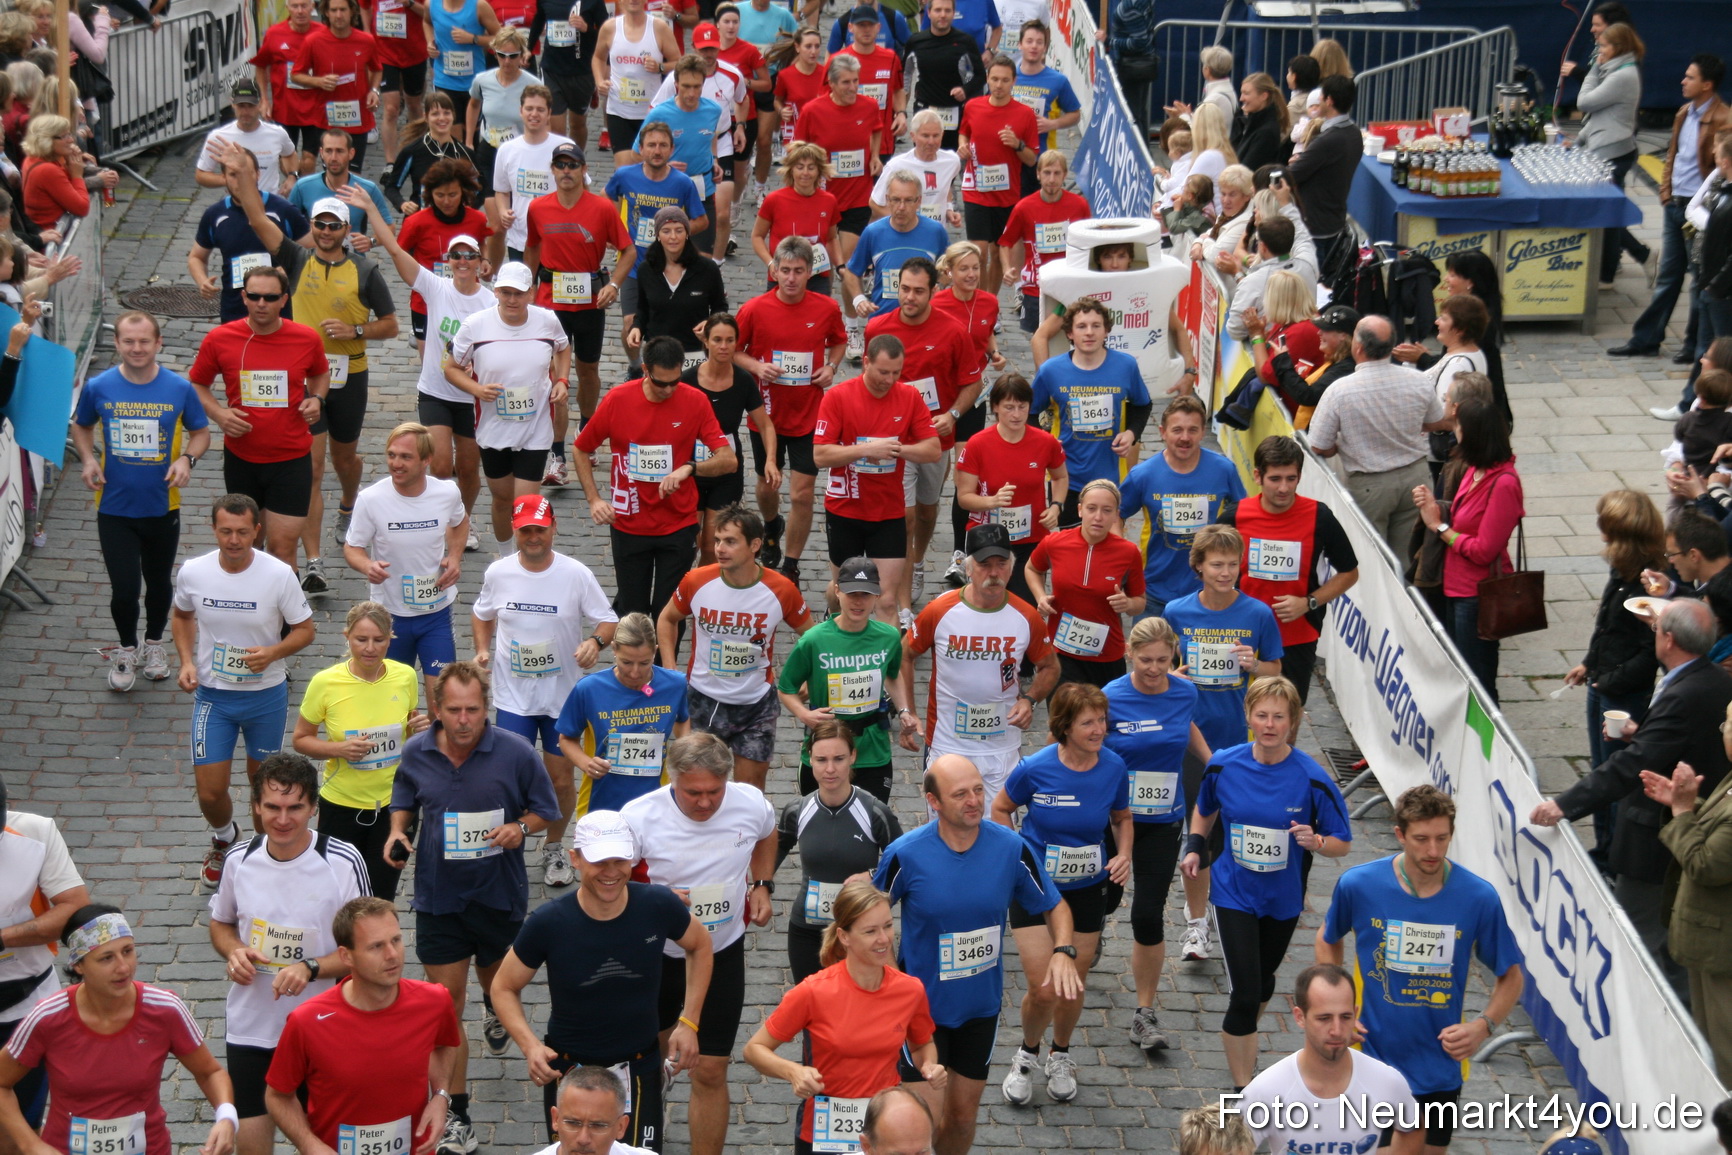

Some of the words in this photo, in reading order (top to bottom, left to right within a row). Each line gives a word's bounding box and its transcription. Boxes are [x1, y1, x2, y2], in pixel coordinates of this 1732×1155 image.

[385, 22, 404, 30] 2529
[554, 30, 573, 38] 3120
[451, 60, 470, 68] 3664
[630, 89, 646, 97] 934
[337, 111, 357, 119] 2570
[841, 160, 861, 169] 3289
[985, 174, 1005, 183] 3550
[526, 181, 550, 191] 2143
[637, 193, 679, 204] NEUMARKTER
[1046, 233, 1067, 243] 2911
[1506, 232, 1587, 273] Glossner
[1547, 255, 1583, 272] Bier
[562, 275, 577, 283] Frank
[566, 284, 585, 294] 658
[784, 354, 796, 362] Fritz
[784, 365, 809, 375] 3545
[252, 373, 283, 382] Alexander
[258, 385, 280, 396] 581
[1070, 386, 1121, 394] NEUMARKTER
[104, 402, 114, 410] 10.
[115, 402, 174, 412] NEUMARKTER
[509, 398, 534, 410] 3313
[763, 389, 771, 415] MAX
[1081, 399, 1100, 407] Martin
[113, 409, 163, 418] STADTLAUF
[1083, 408, 1109, 419] 3643
[122, 422, 145, 430] Markus
[124, 433, 152, 444] 3011
[639, 448, 668, 457] Maximilian
[640, 459, 668, 470] 3563
[850, 472, 860, 499] MAX
[629, 486, 640, 514] MAX
[1174, 501, 1193, 511] Georg
[1175, 510, 1204, 522] 2942
[1002, 518, 1027, 529] 3514
[1263, 542, 1284, 552] Stefan
[1263, 554, 1294, 568] 2970
[416, 578, 436, 587] Stefan
[699, 606, 768, 629] MERZ
[698, 616, 752, 637] Reisen
[1072, 619, 1091, 632] Maria
[1182, 627, 1193, 635] 10.
[1194, 628, 1252, 638] NEUMARKTER
[948, 634, 1017, 652] MERZ
[1069, 631, 1100, 648] 2129
[521, 647, 533, 655] Udo
[724, 644, 749, 653] Michael
[945, 644, 1003, 662] Reisen
[1201, 646, 1218, 655] Anita
[523, 653, 555, 668] 2995
[725, 654, 756, 666] 2863
[818, 649, 888, 671] Sinupret
[1202, 659, 1234, 670] 2490
[842, 673, 874, 686] Elisabeth
[848, 687, 872, 700] 441
[598, 711, 611, 720] 10.
[612, 705, 671, 719] NEUMARKTER
[970, 706, 991, 715] Walter
[610, 714, 660, 727] STADTLAUF
[970, 716, 1001, 728] 2823
[624, 736, 649, 746] Andrea
[623, 748, 656, 760] 3744
[1138, 787, 1170, 799] 3832
[1246, 829, 1266, 839] Petra
[1061, 850, 1097, 860] Hannelore
[1247, 842, 1282, 857] 3243
[1060, 863, 1096, 874] 2013
[694, 901, 730, 917] 3789
[1371, 917, 1384, 930] 10.
[267, 926, 304, 941] Manfred
[1405, 926, 1446, 940] Christoph
[957, 934, 984, 946] Jürgen
[272, 944, 304, 961] 138
[958, 944, 993, 962] 3469
[1405, 942, 1445, 958] 2471
[1408, 979, 1452, 989] 20.09.2009
[833, 1102, 858, 1113] Nicole
[91, 1124, 118, 1135] Petra
[834, 1118, 865, 1134] 233
[360, 1129, 385, 1139] Peter
[92, 1134, 137, 1154] 3511
[361, 1137, 403, 1155] 3510
[1287, 1139, 1353, 1155] terra
